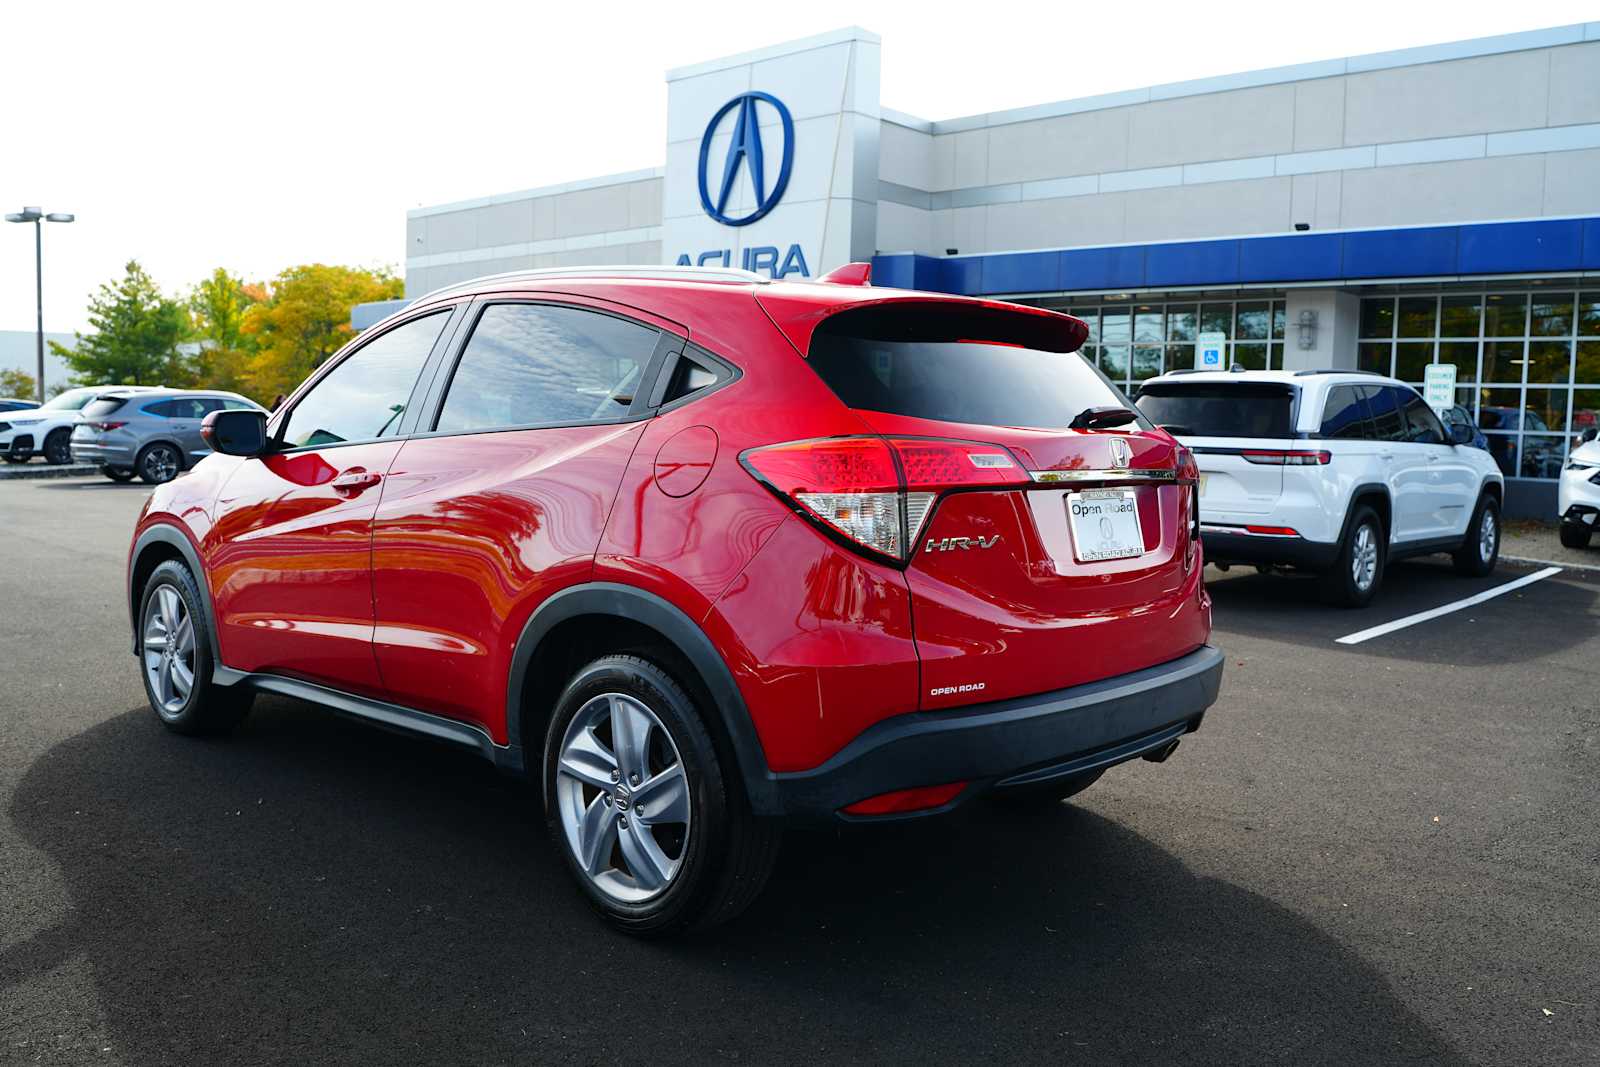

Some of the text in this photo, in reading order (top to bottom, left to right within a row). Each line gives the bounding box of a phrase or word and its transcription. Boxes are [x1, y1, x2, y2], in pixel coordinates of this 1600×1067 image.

[1072, 502, 1133, 517] Open Road
[925, 535, 1000, 552] HR-V
[931, 682, 985, 696] OPEN ROAD
